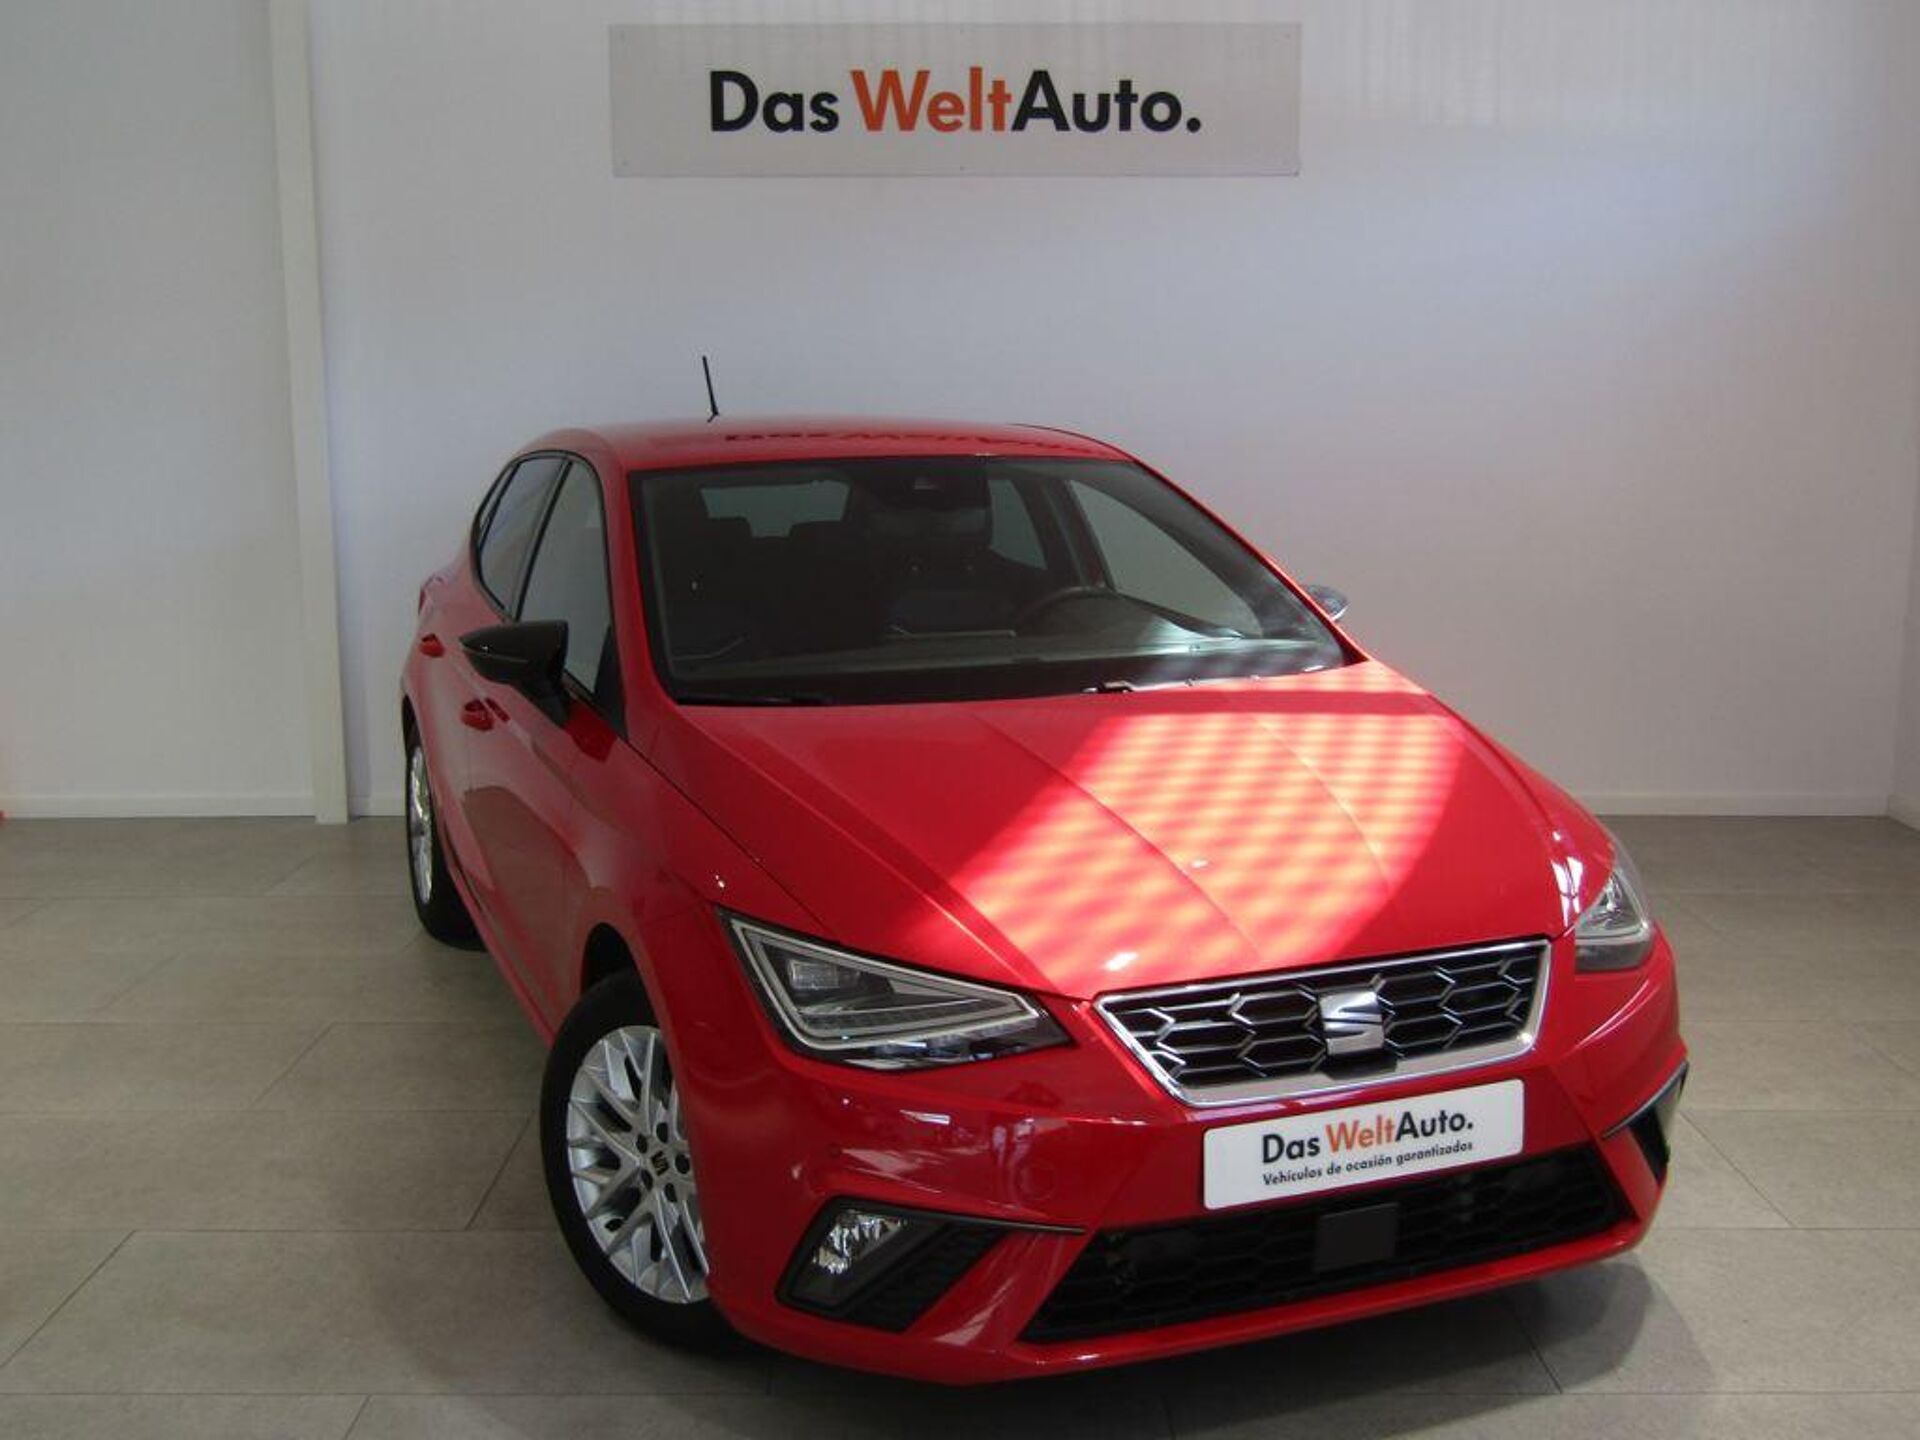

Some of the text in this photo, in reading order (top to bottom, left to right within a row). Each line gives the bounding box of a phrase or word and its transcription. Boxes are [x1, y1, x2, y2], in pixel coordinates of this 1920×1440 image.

[709, 66, 1202, 133] Das WeltAuto.
[1262, 1110, 1474, 1164] Das WeltAuto.
[1326, 1163, 1341, 1176] de
[1346, 1154, 1392, 1172] ocasión
[1396, 1140, 1473, 1166] garantizados
